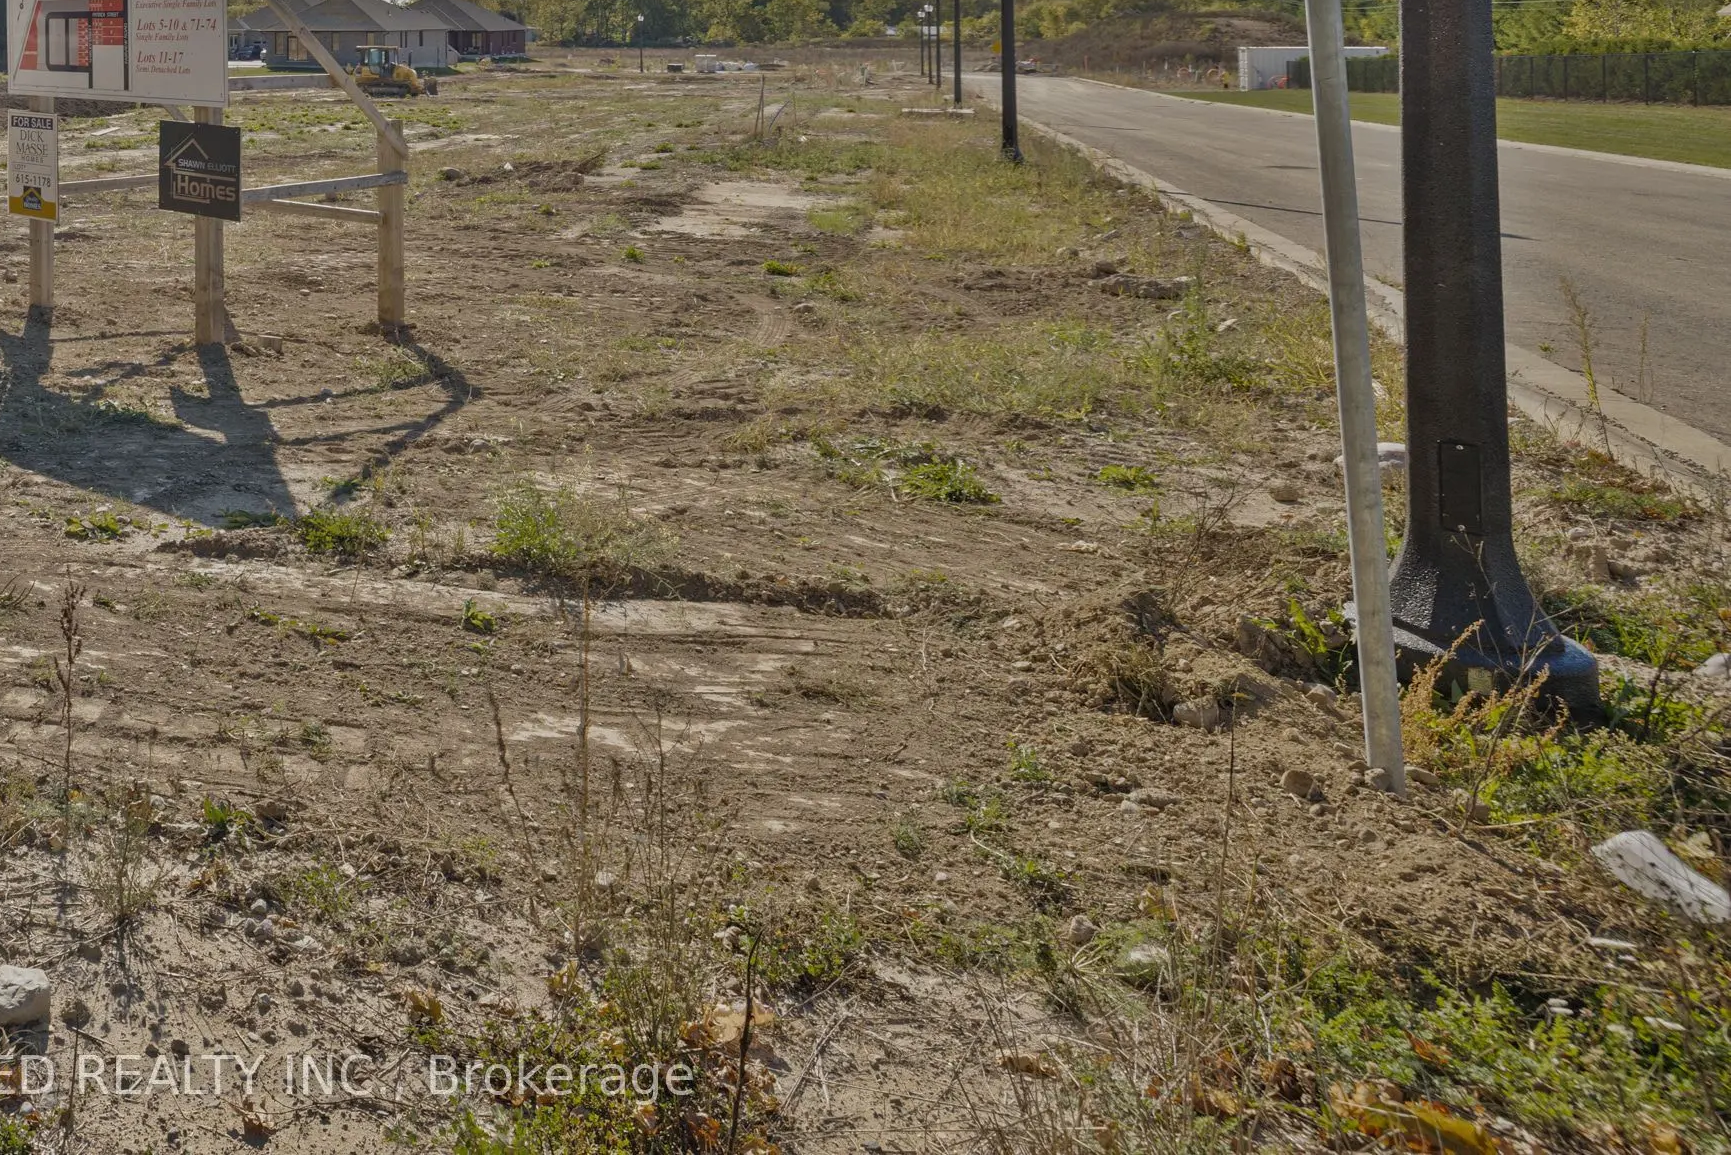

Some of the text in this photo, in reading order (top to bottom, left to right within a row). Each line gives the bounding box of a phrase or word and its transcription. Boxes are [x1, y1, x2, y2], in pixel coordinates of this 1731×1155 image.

[136, 18, 217, 32] Lots 5-10 & 71-74
[137, 51, 184, 64] Lots 11-17
[12, 116, 52, 130] FOR SALE
[20, 129, 44, 142] DICK
[16, 142, 48, 156] MASSE
[178, 158, 236, 173] SHAWN ELLIOTT
[177, 174, 236, 201] Homes
